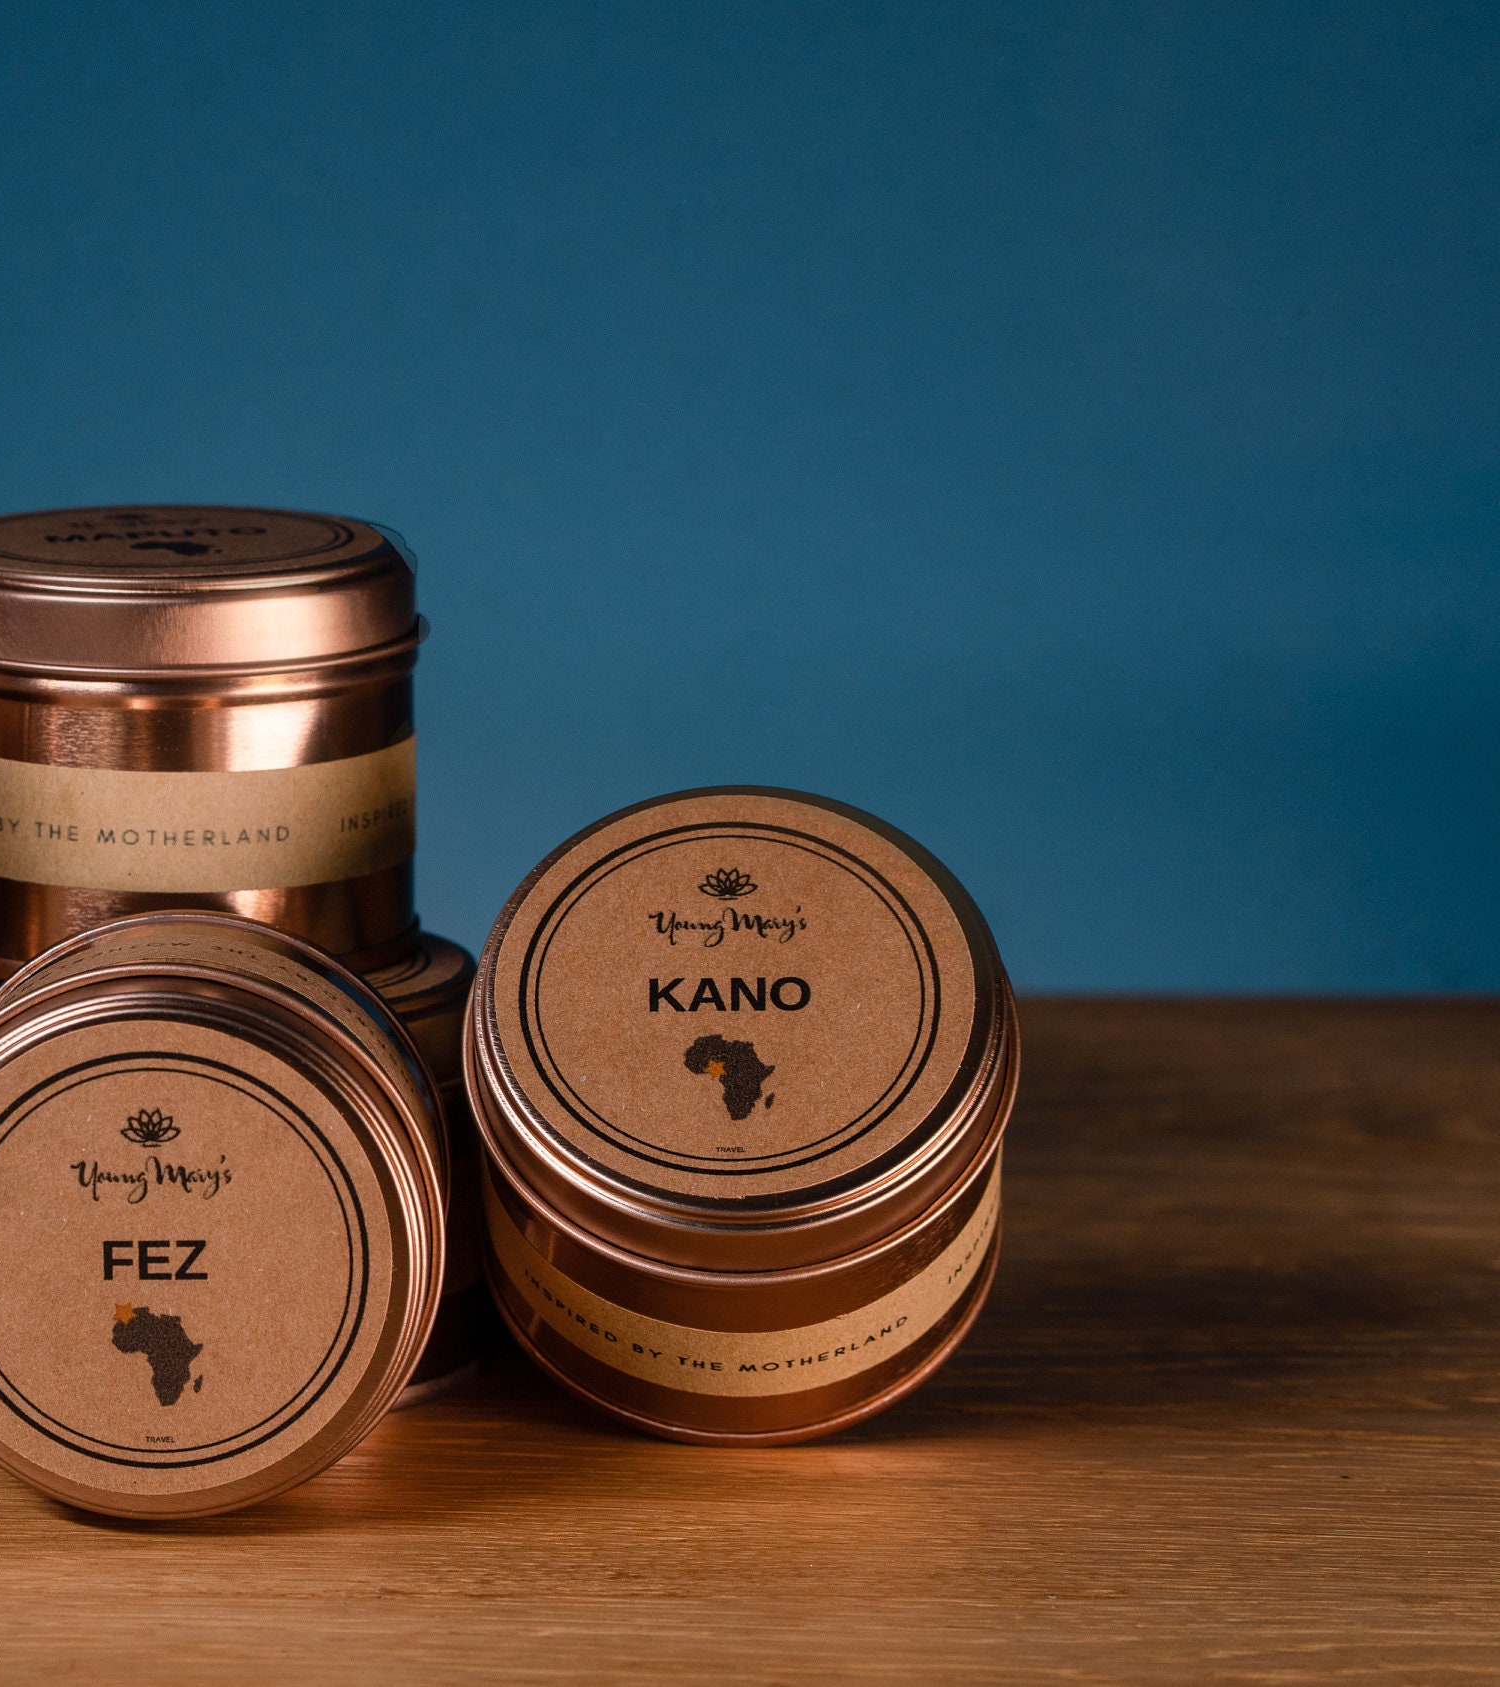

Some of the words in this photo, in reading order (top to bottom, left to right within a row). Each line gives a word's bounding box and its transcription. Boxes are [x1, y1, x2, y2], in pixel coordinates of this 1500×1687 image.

[44, 526, 267, 543] MAPUTO
[36, 821, 79, 842] THE
[97, 825, 290, 846] MOTHERLAND
[649, 909, 725, 948] Young
[722, 905, 807, 944] Mary's
[649, 976, 811, 1012] KANO
[70, 1160, 148, 1204] Young
[145, 1154, 232, 1200] Mary's
[103, 1240, 208, 1280] FEZ
[525, 1269, 618, 1343] INSPIRED
[632, 1343, 663, 1359] BY
[677, 1356, 723, 1371] THE
[738, 1316, 908, 1372] MOTHERLAND
